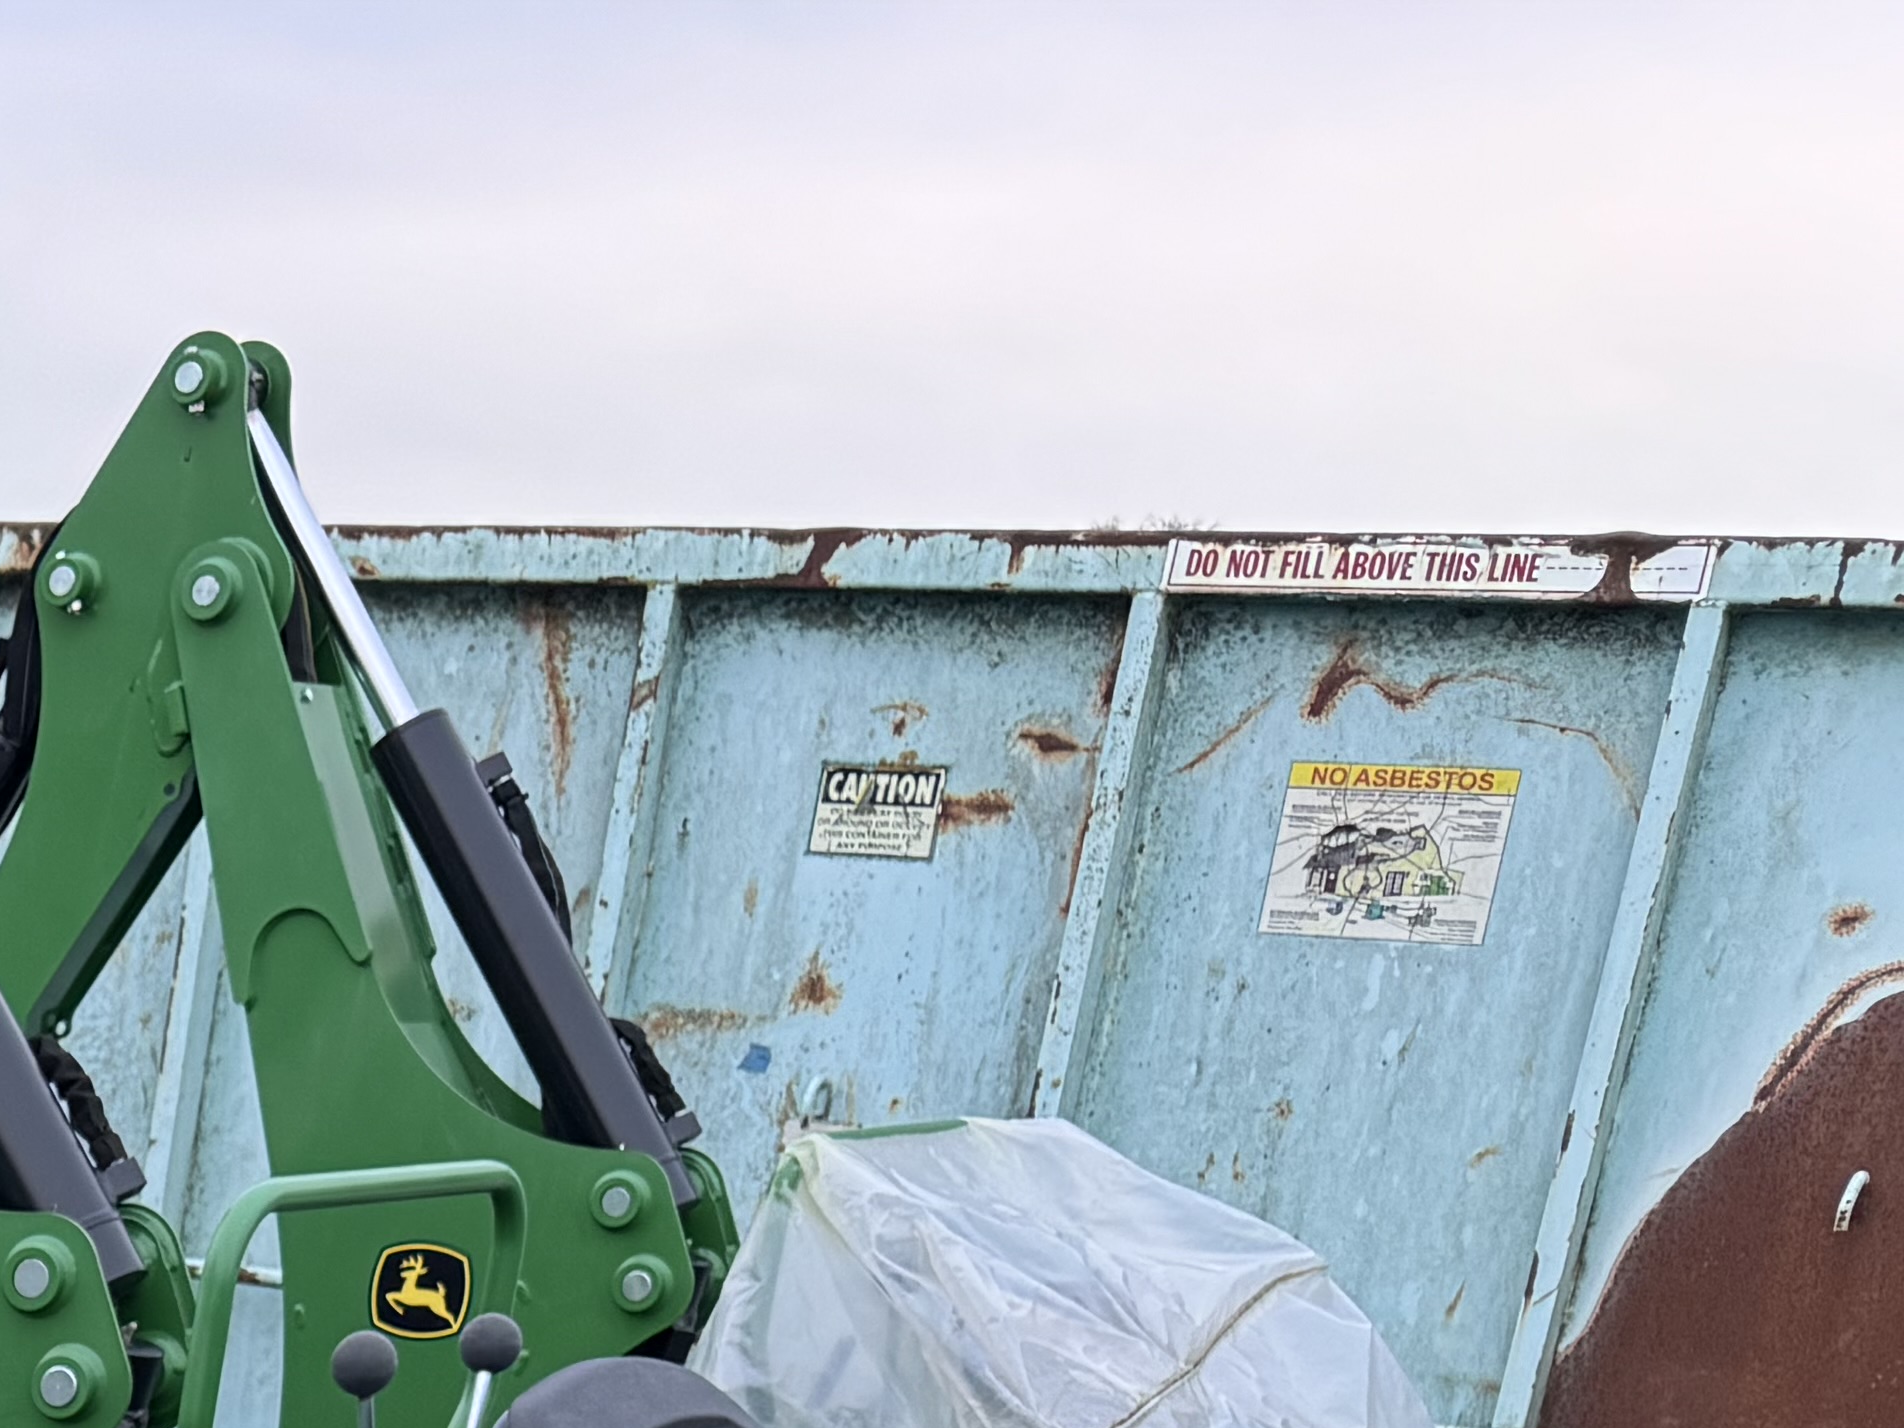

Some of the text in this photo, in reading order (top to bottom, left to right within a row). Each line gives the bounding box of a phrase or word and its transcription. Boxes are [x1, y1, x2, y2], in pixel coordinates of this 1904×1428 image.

[1185, 549, 1543, 583] DO NOT FILL ABOVE THIS LINE
[828, 771, 937, 805] CAUTION
[1310, 766, 1496, 791] NO ASBESTOS
